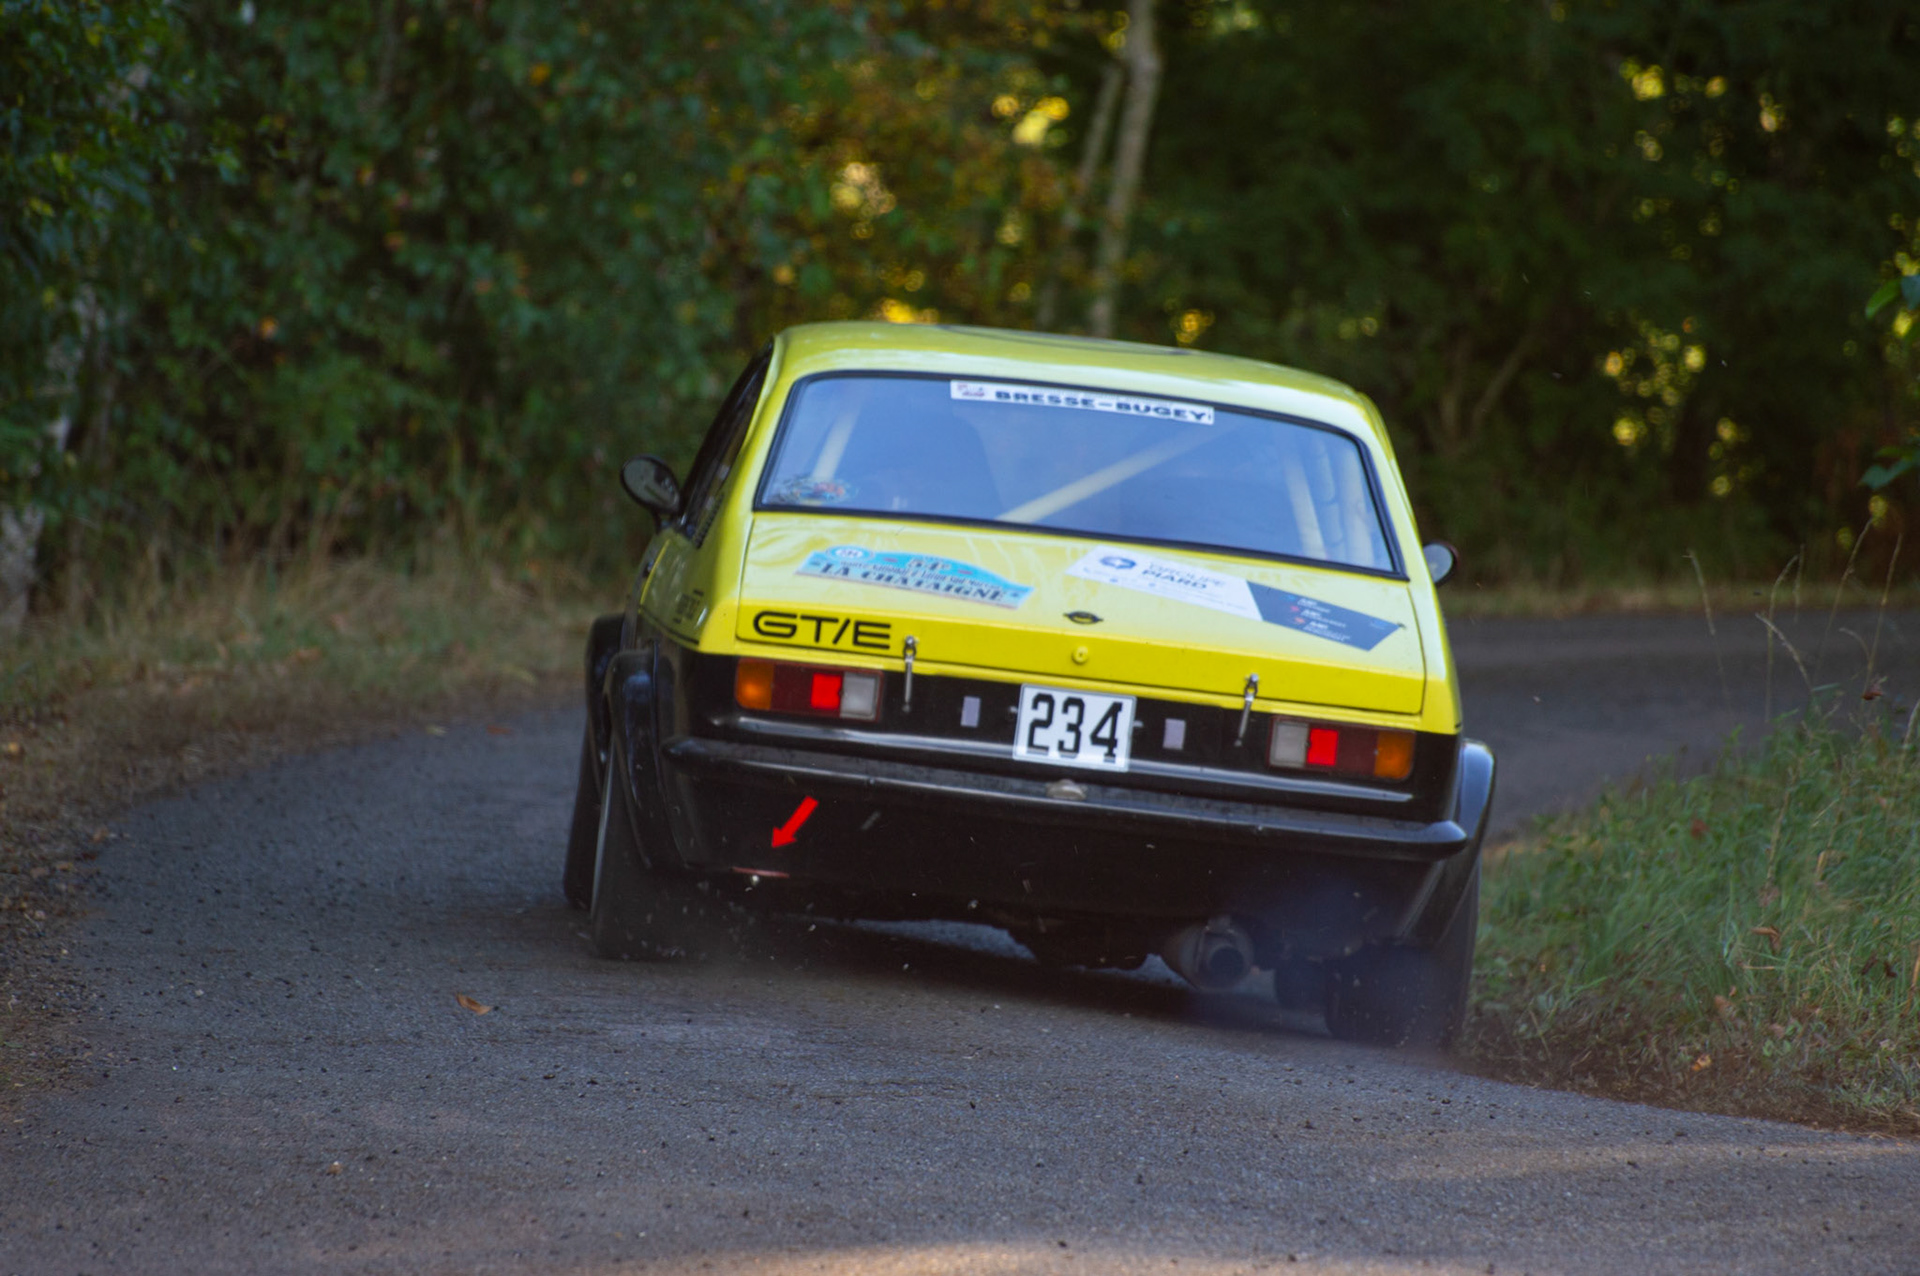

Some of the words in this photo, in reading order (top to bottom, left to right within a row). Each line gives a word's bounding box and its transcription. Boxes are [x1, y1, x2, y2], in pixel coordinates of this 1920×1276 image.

[820, 562, 851, 577] LA
[753, 610, 892, 650] GT/E
[1026, 691, 1123, 764] 234
